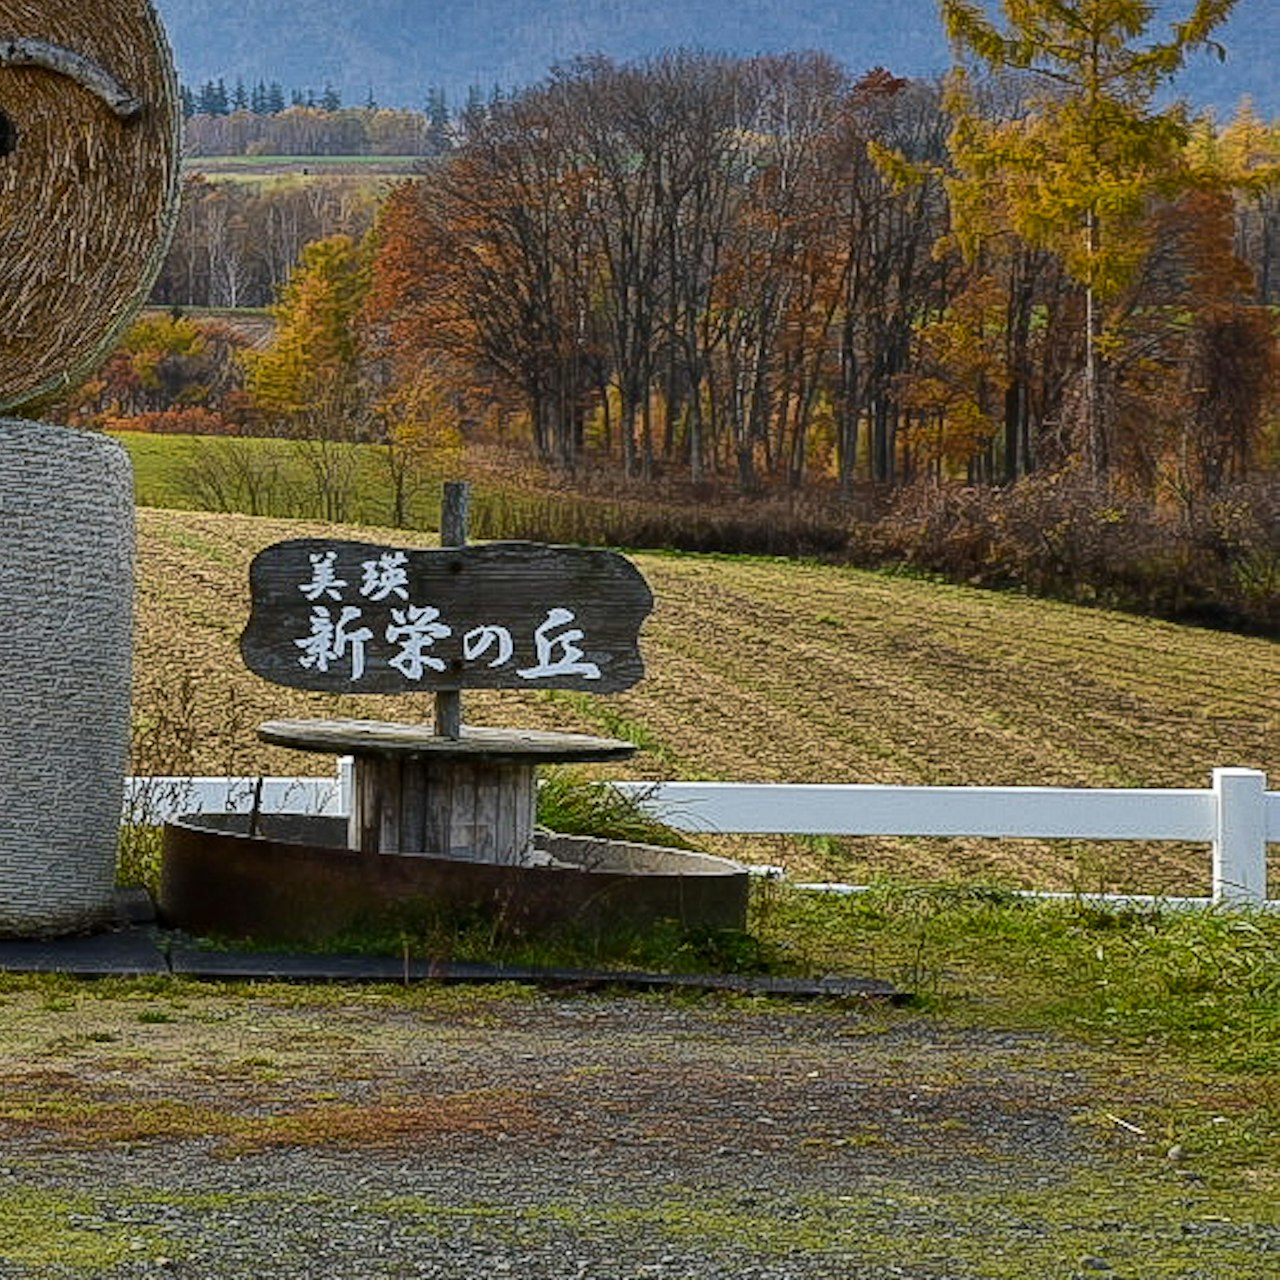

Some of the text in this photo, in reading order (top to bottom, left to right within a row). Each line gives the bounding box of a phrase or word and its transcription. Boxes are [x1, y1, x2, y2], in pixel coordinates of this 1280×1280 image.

[298, 551, 410, 601] 美瑛
[294, 606, 601, 681] 新栄の丘
